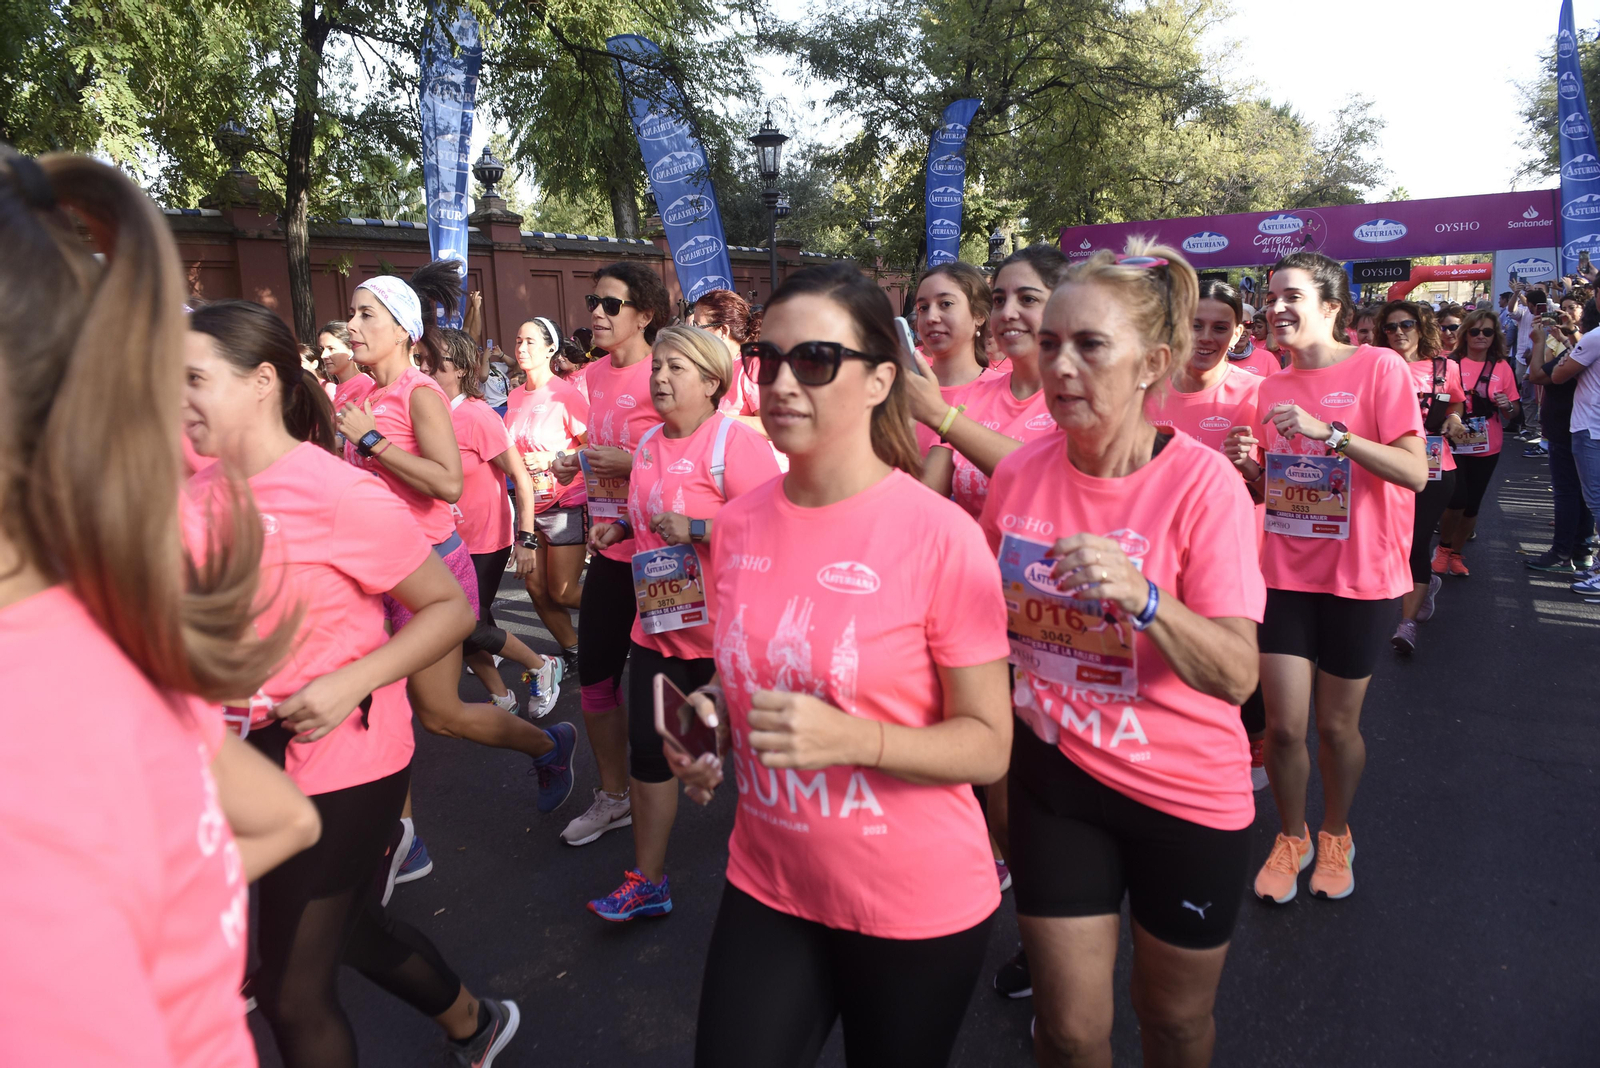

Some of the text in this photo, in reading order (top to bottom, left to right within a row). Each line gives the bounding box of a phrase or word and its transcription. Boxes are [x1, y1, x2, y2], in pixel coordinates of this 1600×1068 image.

[1262, 222, 1300, 231] ASTURIANA
[1435, 221, 1480, 234] OYSHO
[1507, 218, 1554, 229] Santander
[1358, 228, 1404, 238] ASTURIANA
[1186, 240, 1226, 249] ASTURIANA
[1362, 267, 1402, 277] OYSHO
[1434, 269, 1450, 277] Sports
[1511, 262, 1551, 274] ASTURIANA
[1286, 468, 1321, 479] ASTURIANA
[1285, 486, 1320, 503] 016
[1291, 504, 1310, 513] 3533
[646, 562, 677, 574] ASTURIANA
[823, 571, 875, 591] ASTURIANA
[648, 578, 680, 598] 016
[657, 598, 675, 608] 3870
[1025, 598, 1084, 632] 016
[1040, 630, 1072, 645] 3042
[862, 824, 888, 836] 2022
